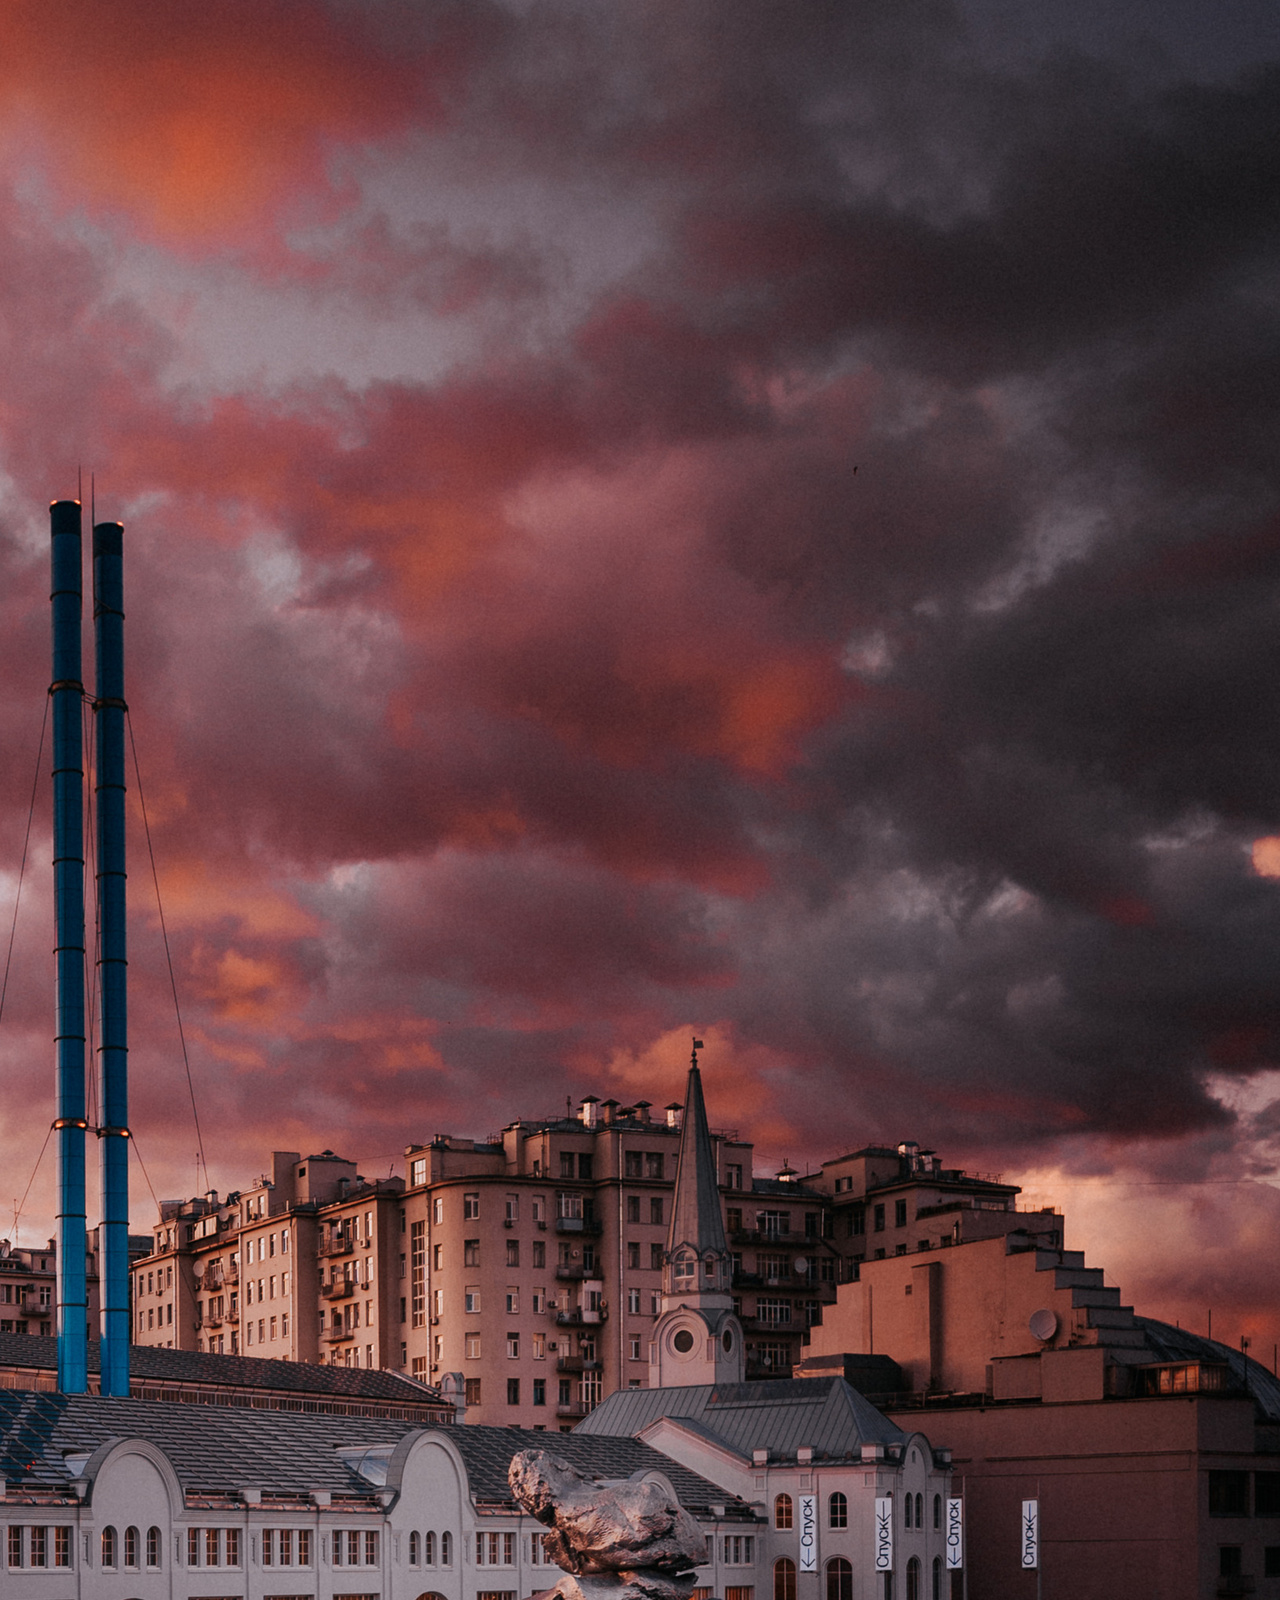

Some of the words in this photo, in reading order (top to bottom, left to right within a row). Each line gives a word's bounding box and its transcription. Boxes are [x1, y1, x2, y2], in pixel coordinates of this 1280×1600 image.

[801, 1499, 815, 1547] Спуск
[876, 1521, 891, 1567] Спуск
[947, 1502, 961, 1546] Спуск
[1023, 1522, 1036, 1565] Спуск
